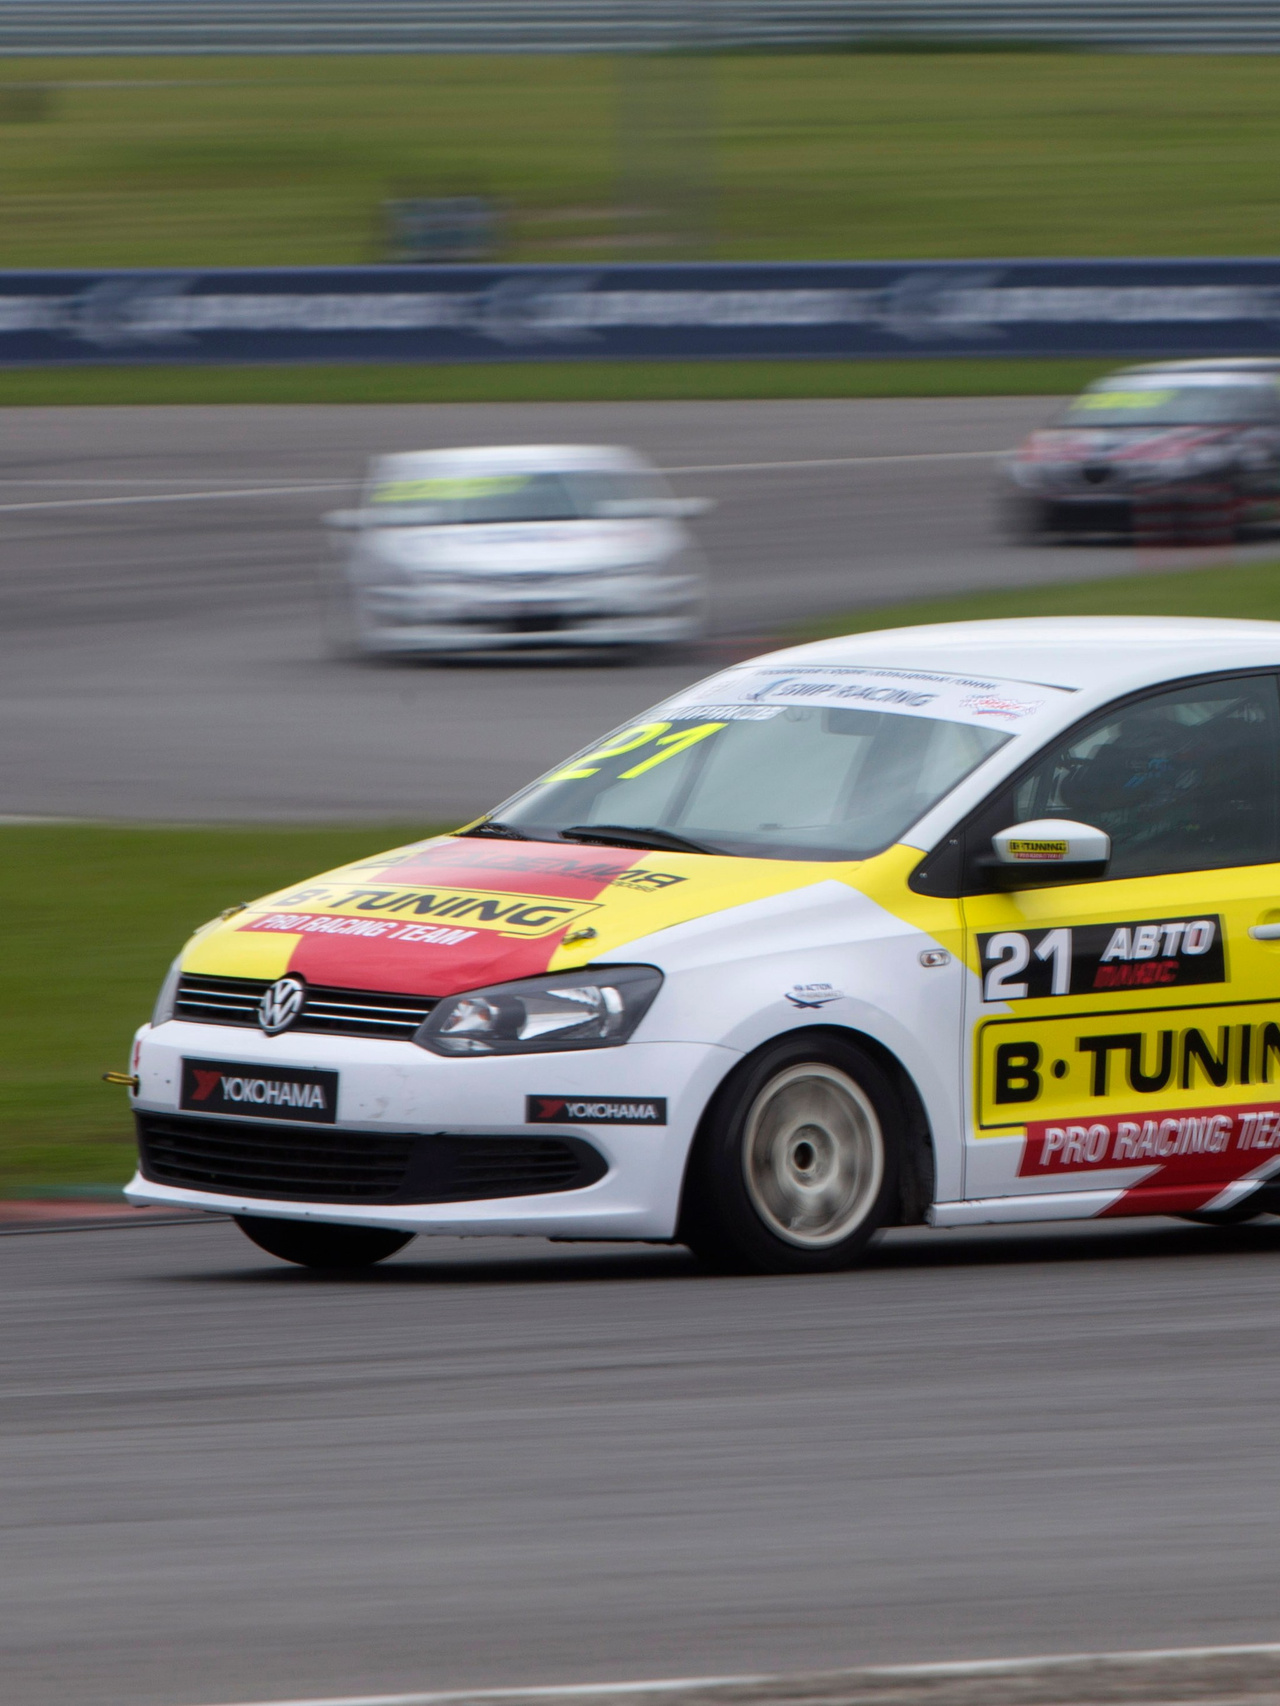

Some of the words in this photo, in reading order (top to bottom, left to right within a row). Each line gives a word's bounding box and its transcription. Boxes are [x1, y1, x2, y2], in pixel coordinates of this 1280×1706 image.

[832, 685, 940, 707] RACING
[540, 722, 730, 784] 21
[252, 914, 302, 930] PRO
[299, 916, 388, 938] RACING
[386, 923, 479, 946] TEAM
[985, 928, 1072, 1001] 21
[219, 1075, 326, 1109] YOKOHAMA
[564, 1101, 660, 1120] YOKOHAMA
[1039, 1123, 1112, 1167] PRO
[1111, 1114, 1236, 1161] RACING
